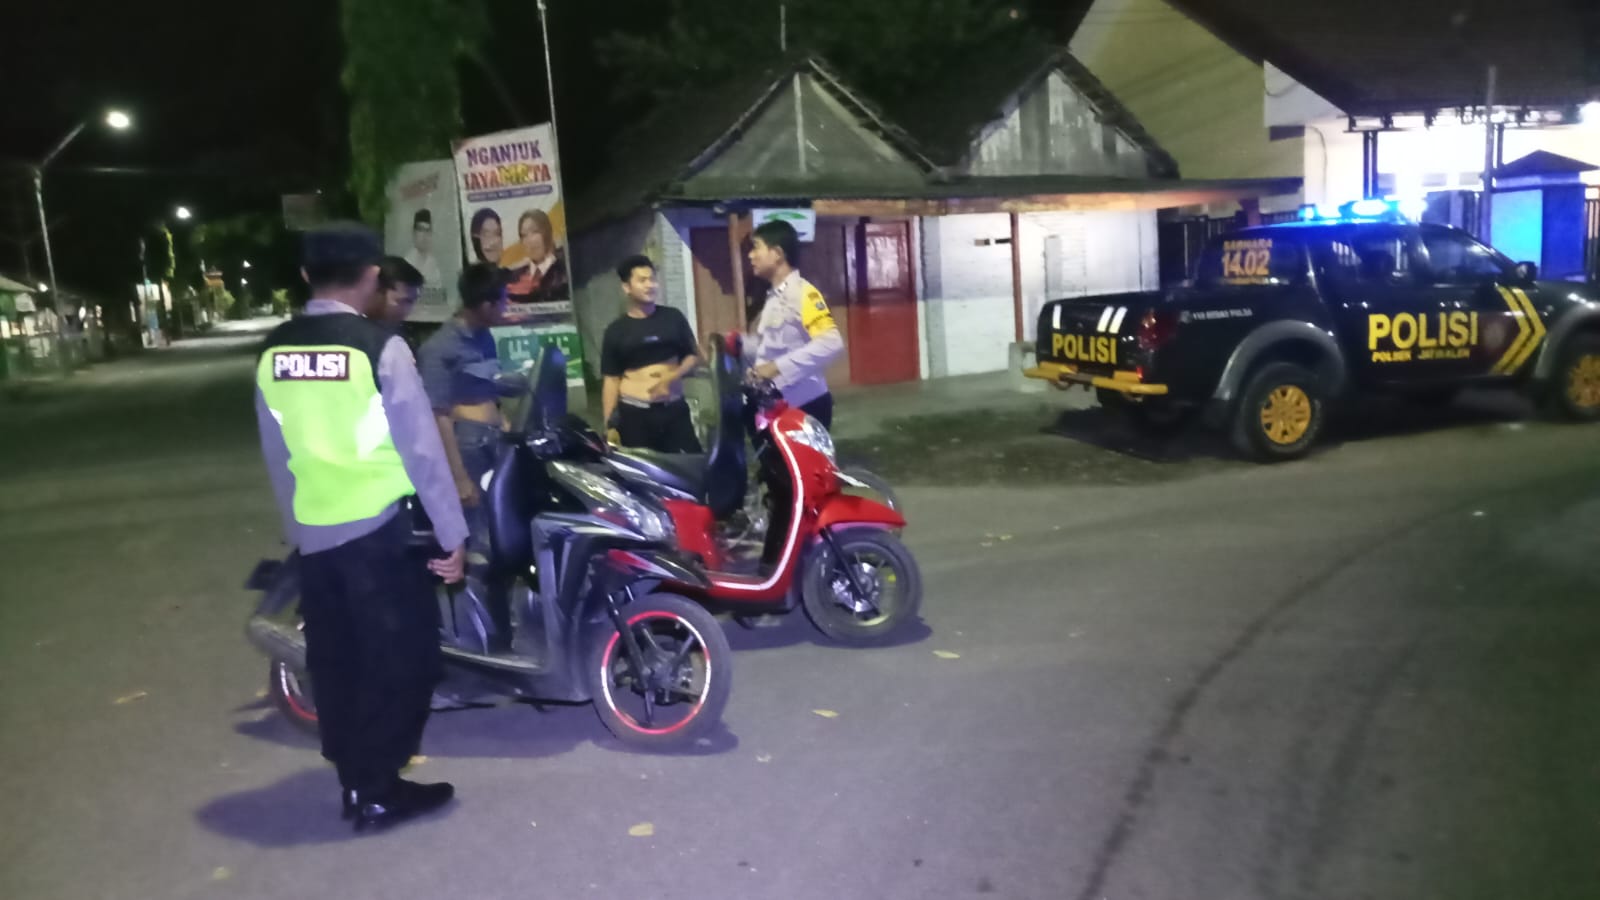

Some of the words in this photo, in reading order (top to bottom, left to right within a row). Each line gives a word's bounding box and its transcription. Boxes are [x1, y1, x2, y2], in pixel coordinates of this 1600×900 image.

[466, 140, 541, 168] NGANJUK
[1368, 310, 1478, 351] POLISI
[1052, 332, 1117, 365] POLISI
[274, 353, 346, 378] POLISI
